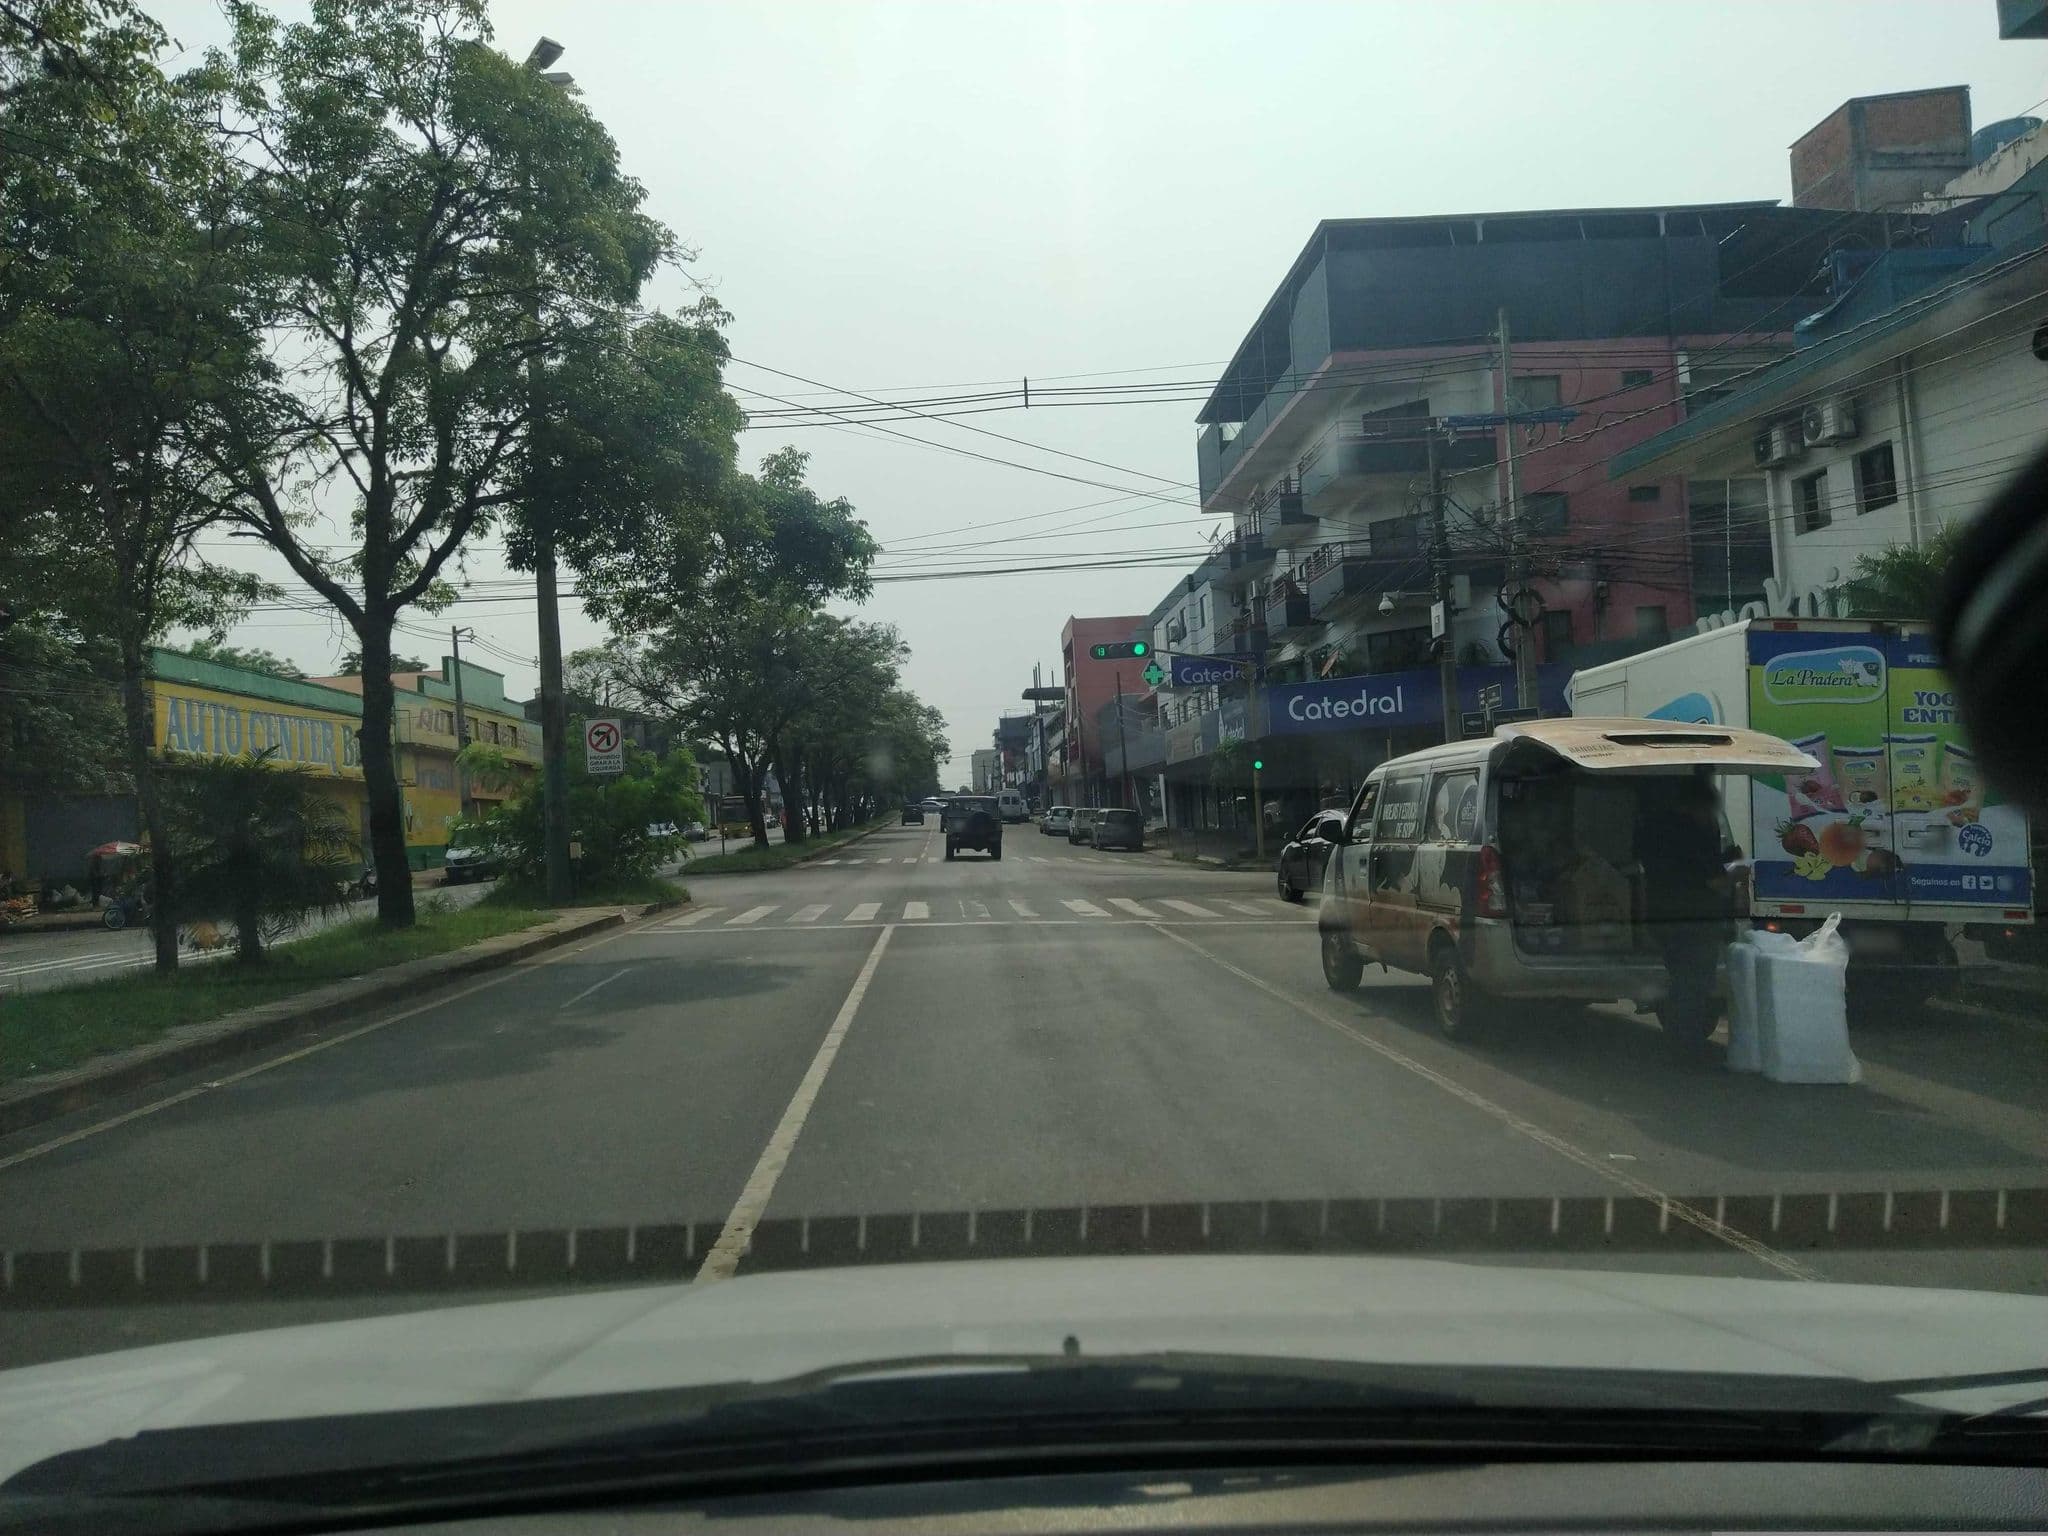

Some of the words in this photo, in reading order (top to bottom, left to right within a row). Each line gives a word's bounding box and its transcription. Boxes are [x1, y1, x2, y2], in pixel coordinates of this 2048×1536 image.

[1181, 665, 1242, 684] Catedr
[1767, 668, 1794, 686] La
[1796, 668, 1853, 687] Pradera
[1289, 686, 1402, 721] Catedral
[166, 696, 242, 757] AUTO
[248, 710, 338, 776] CENTER
